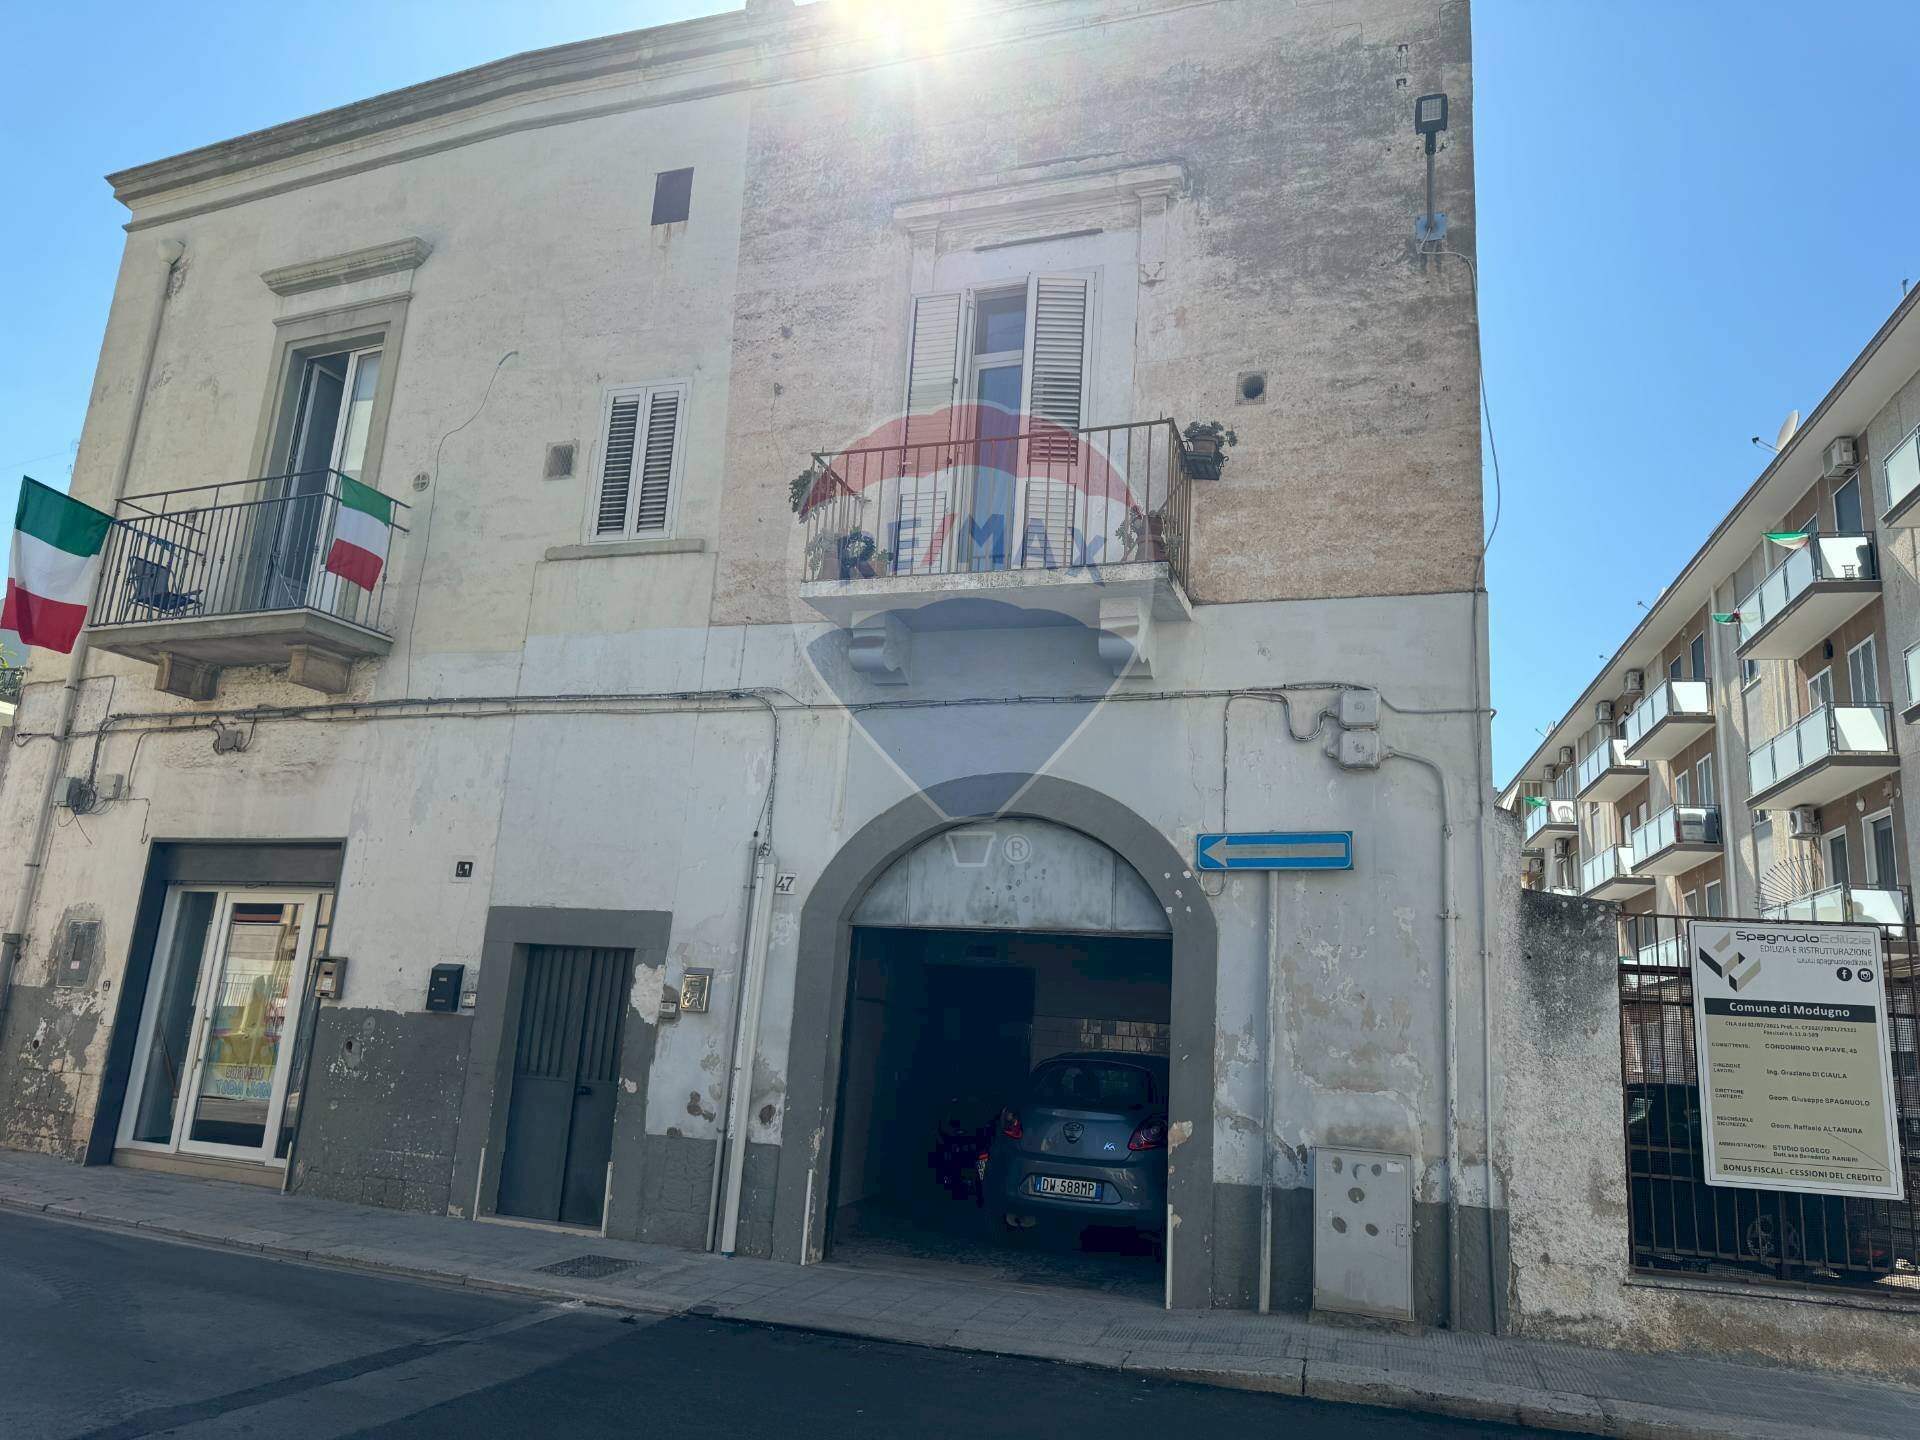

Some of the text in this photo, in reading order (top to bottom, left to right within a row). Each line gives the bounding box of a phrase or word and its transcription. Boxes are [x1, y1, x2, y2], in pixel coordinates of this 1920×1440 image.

[776, 876, 795, 892] 47
[1760, 945, 1791, 953] EDILIZIA
[1799, 947, 1873, 957] RISTRUTTURAZIONE
[1729, 1002, 1851, 1018] Comune di Modugno
[1764, 1043, 1811, 1052] CONDOMINIO
[1780, 1069, 1811, 1077] Graziano
[1820, 1071, 1848, 1079] CIAULA
[1791, 1095, 1824, 1105] Giuseppe
[1824, 1097, 1870, 1107] SPAGNUOLO
[1793, 1123, 1822, 1132] Raffaele
[1822, 1125, 1863, 1134] ALTAMURA
[1772, 1144, 1799, 1152] STUDIO
[1723, 1163, 1752, 1173] BONUS
[1753, 1166, 1784, 1175] FISCALI
[1789, 1169, 1828, 1179] CESSIONI
[1829, 1172, 1845, 1180] DEL
[1846, 1173, 1883, 1183] CREDITO
[1042, 1178, 1056, 1192] DW
[1059, 1181, 1095, 1196] 588MP
